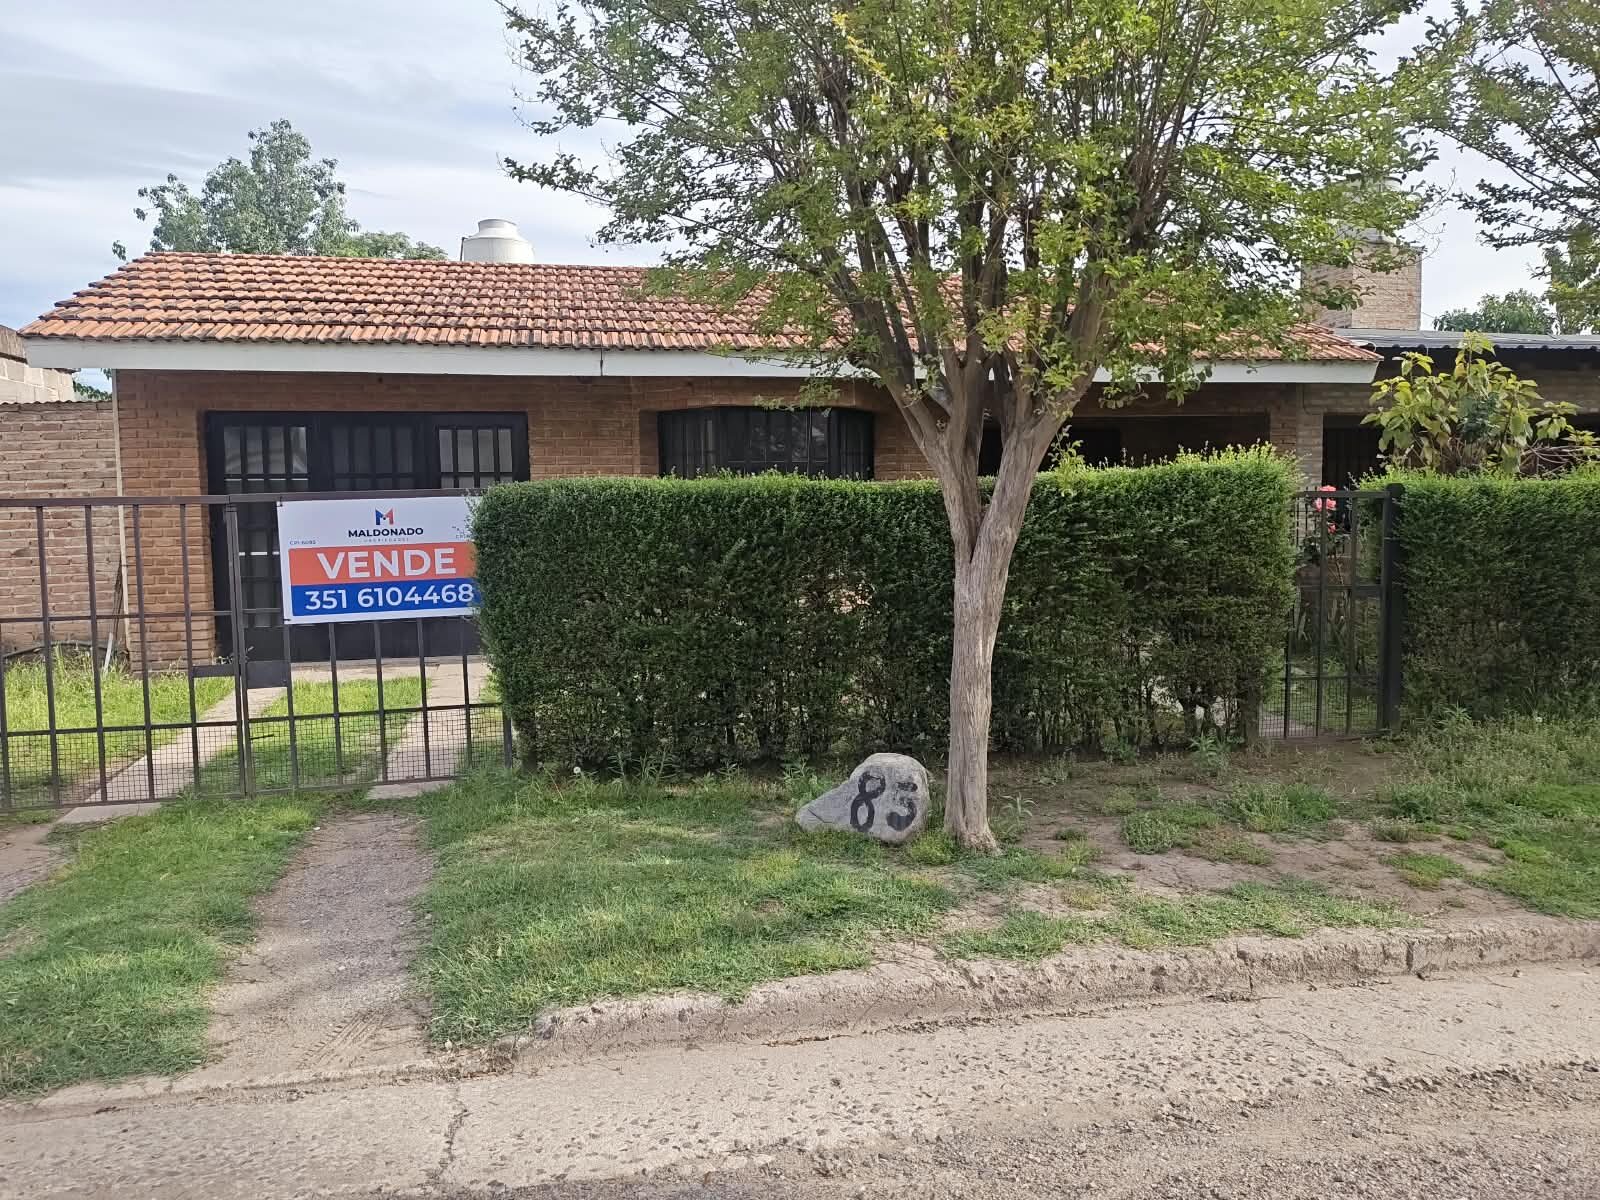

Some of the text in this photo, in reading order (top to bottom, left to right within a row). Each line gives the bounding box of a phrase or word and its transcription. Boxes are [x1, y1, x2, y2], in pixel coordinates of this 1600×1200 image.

[348, 527, 424, 538] MALDONADO
[316, 547, 457, 580] VENDE
[305, 582, 475, 611] 351 6104468
[850, 771, 918, 832] 85
